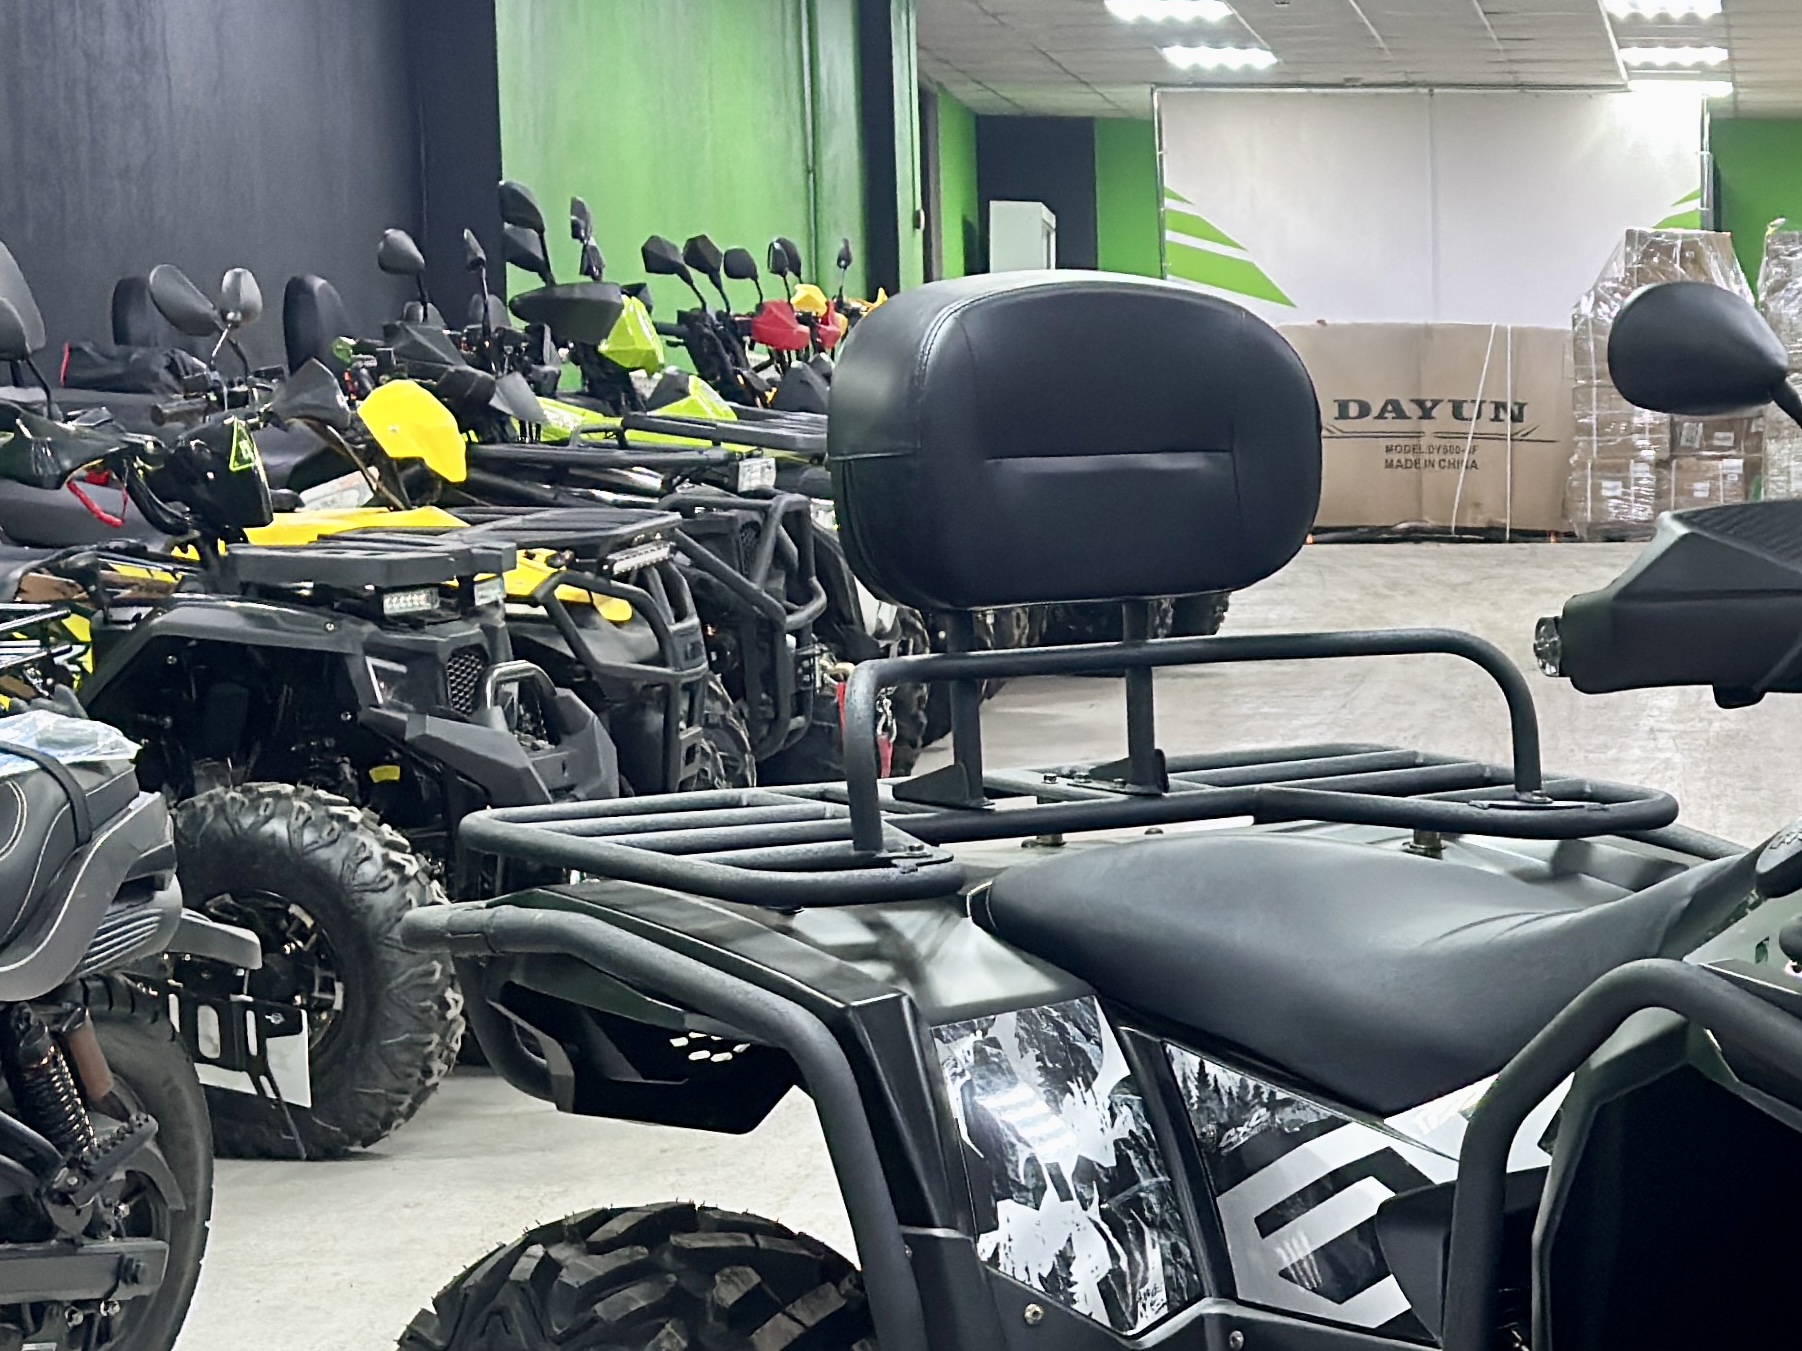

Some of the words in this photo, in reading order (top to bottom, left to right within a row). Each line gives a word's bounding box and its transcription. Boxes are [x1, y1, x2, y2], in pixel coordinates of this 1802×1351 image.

[1333, 399, 1529, 424] DAYUN
[1384, 459, 1421, 470] MADE
[1424, 459, 1436, 469] IN
